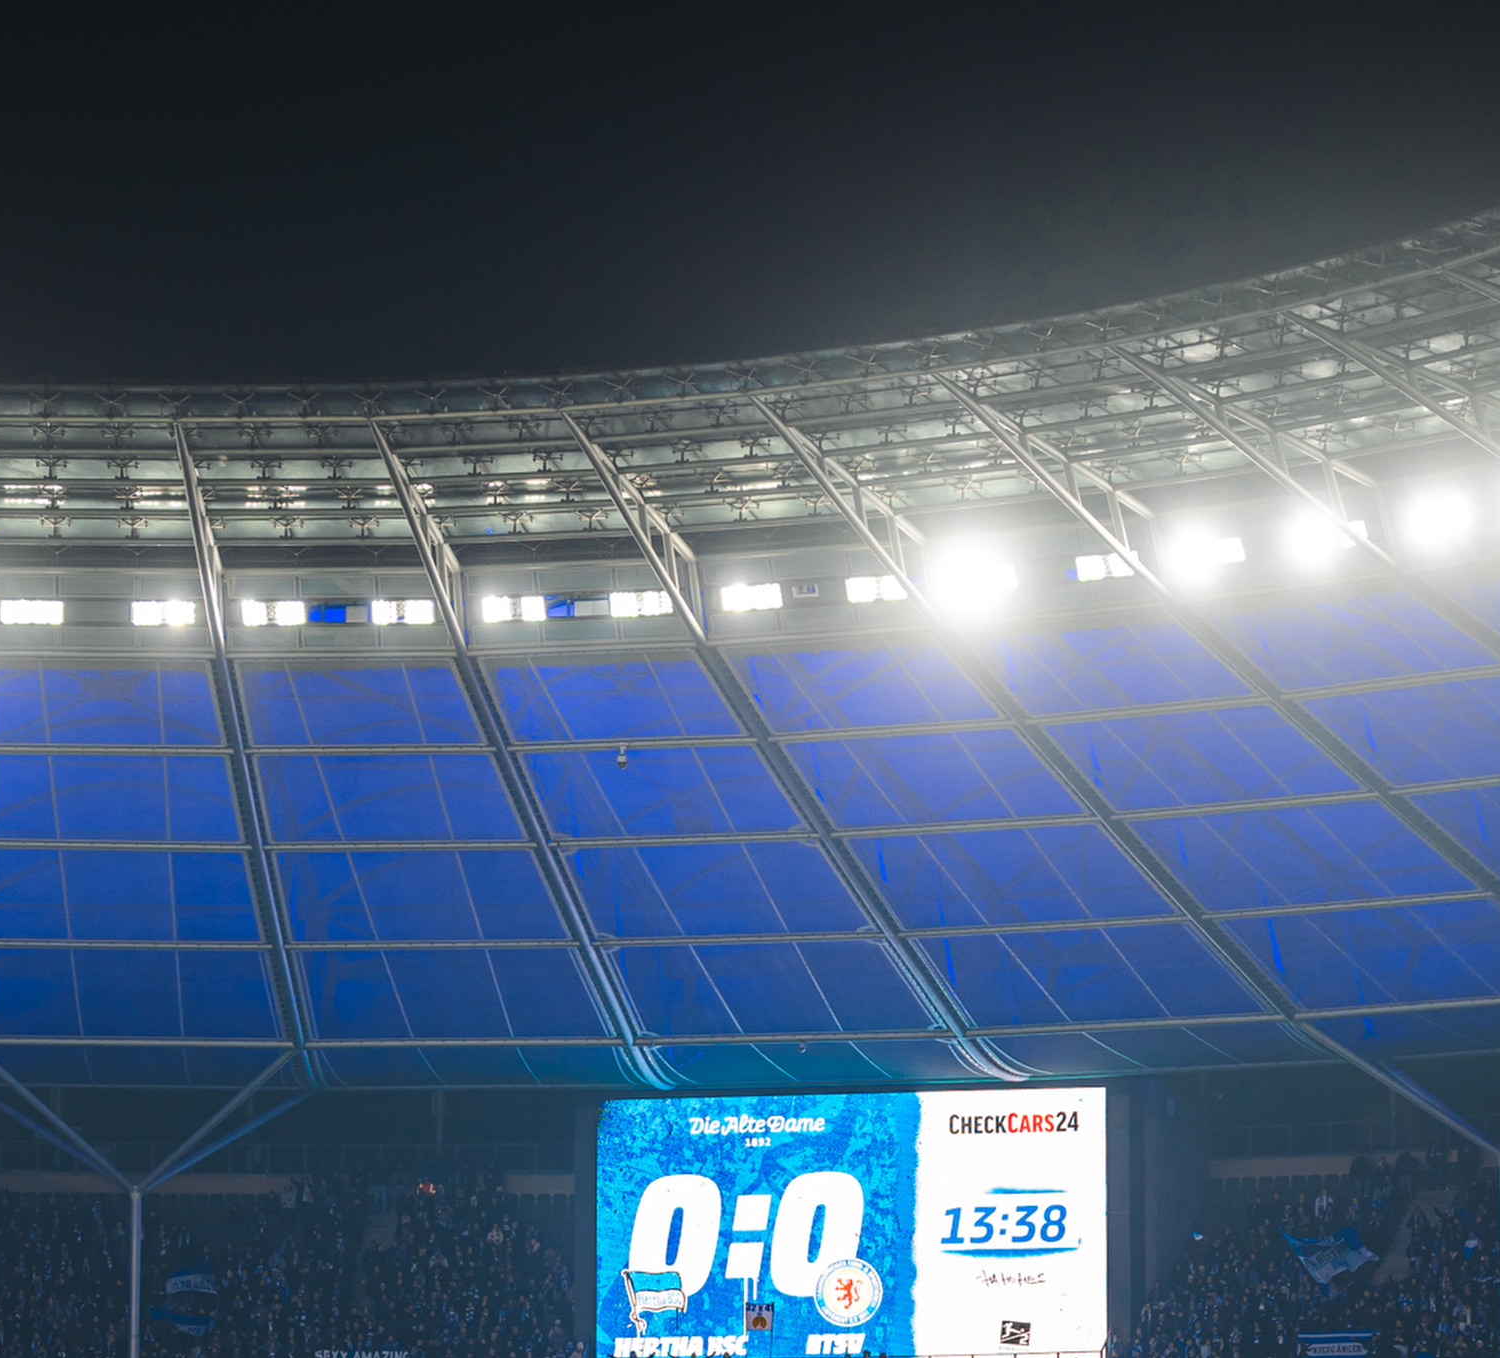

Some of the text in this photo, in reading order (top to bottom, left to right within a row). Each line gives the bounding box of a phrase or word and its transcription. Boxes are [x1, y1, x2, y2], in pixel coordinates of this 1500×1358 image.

[688, 1113, 826, 1136] Die Alte Dame
[949, 1111, 1079, 1135] CHECKCARS24
[744, 1137, 771, 1147] 1892
[627, 1171, 864, 1298] 0:0
[941, 1204, 1068, 1244] 13:38
